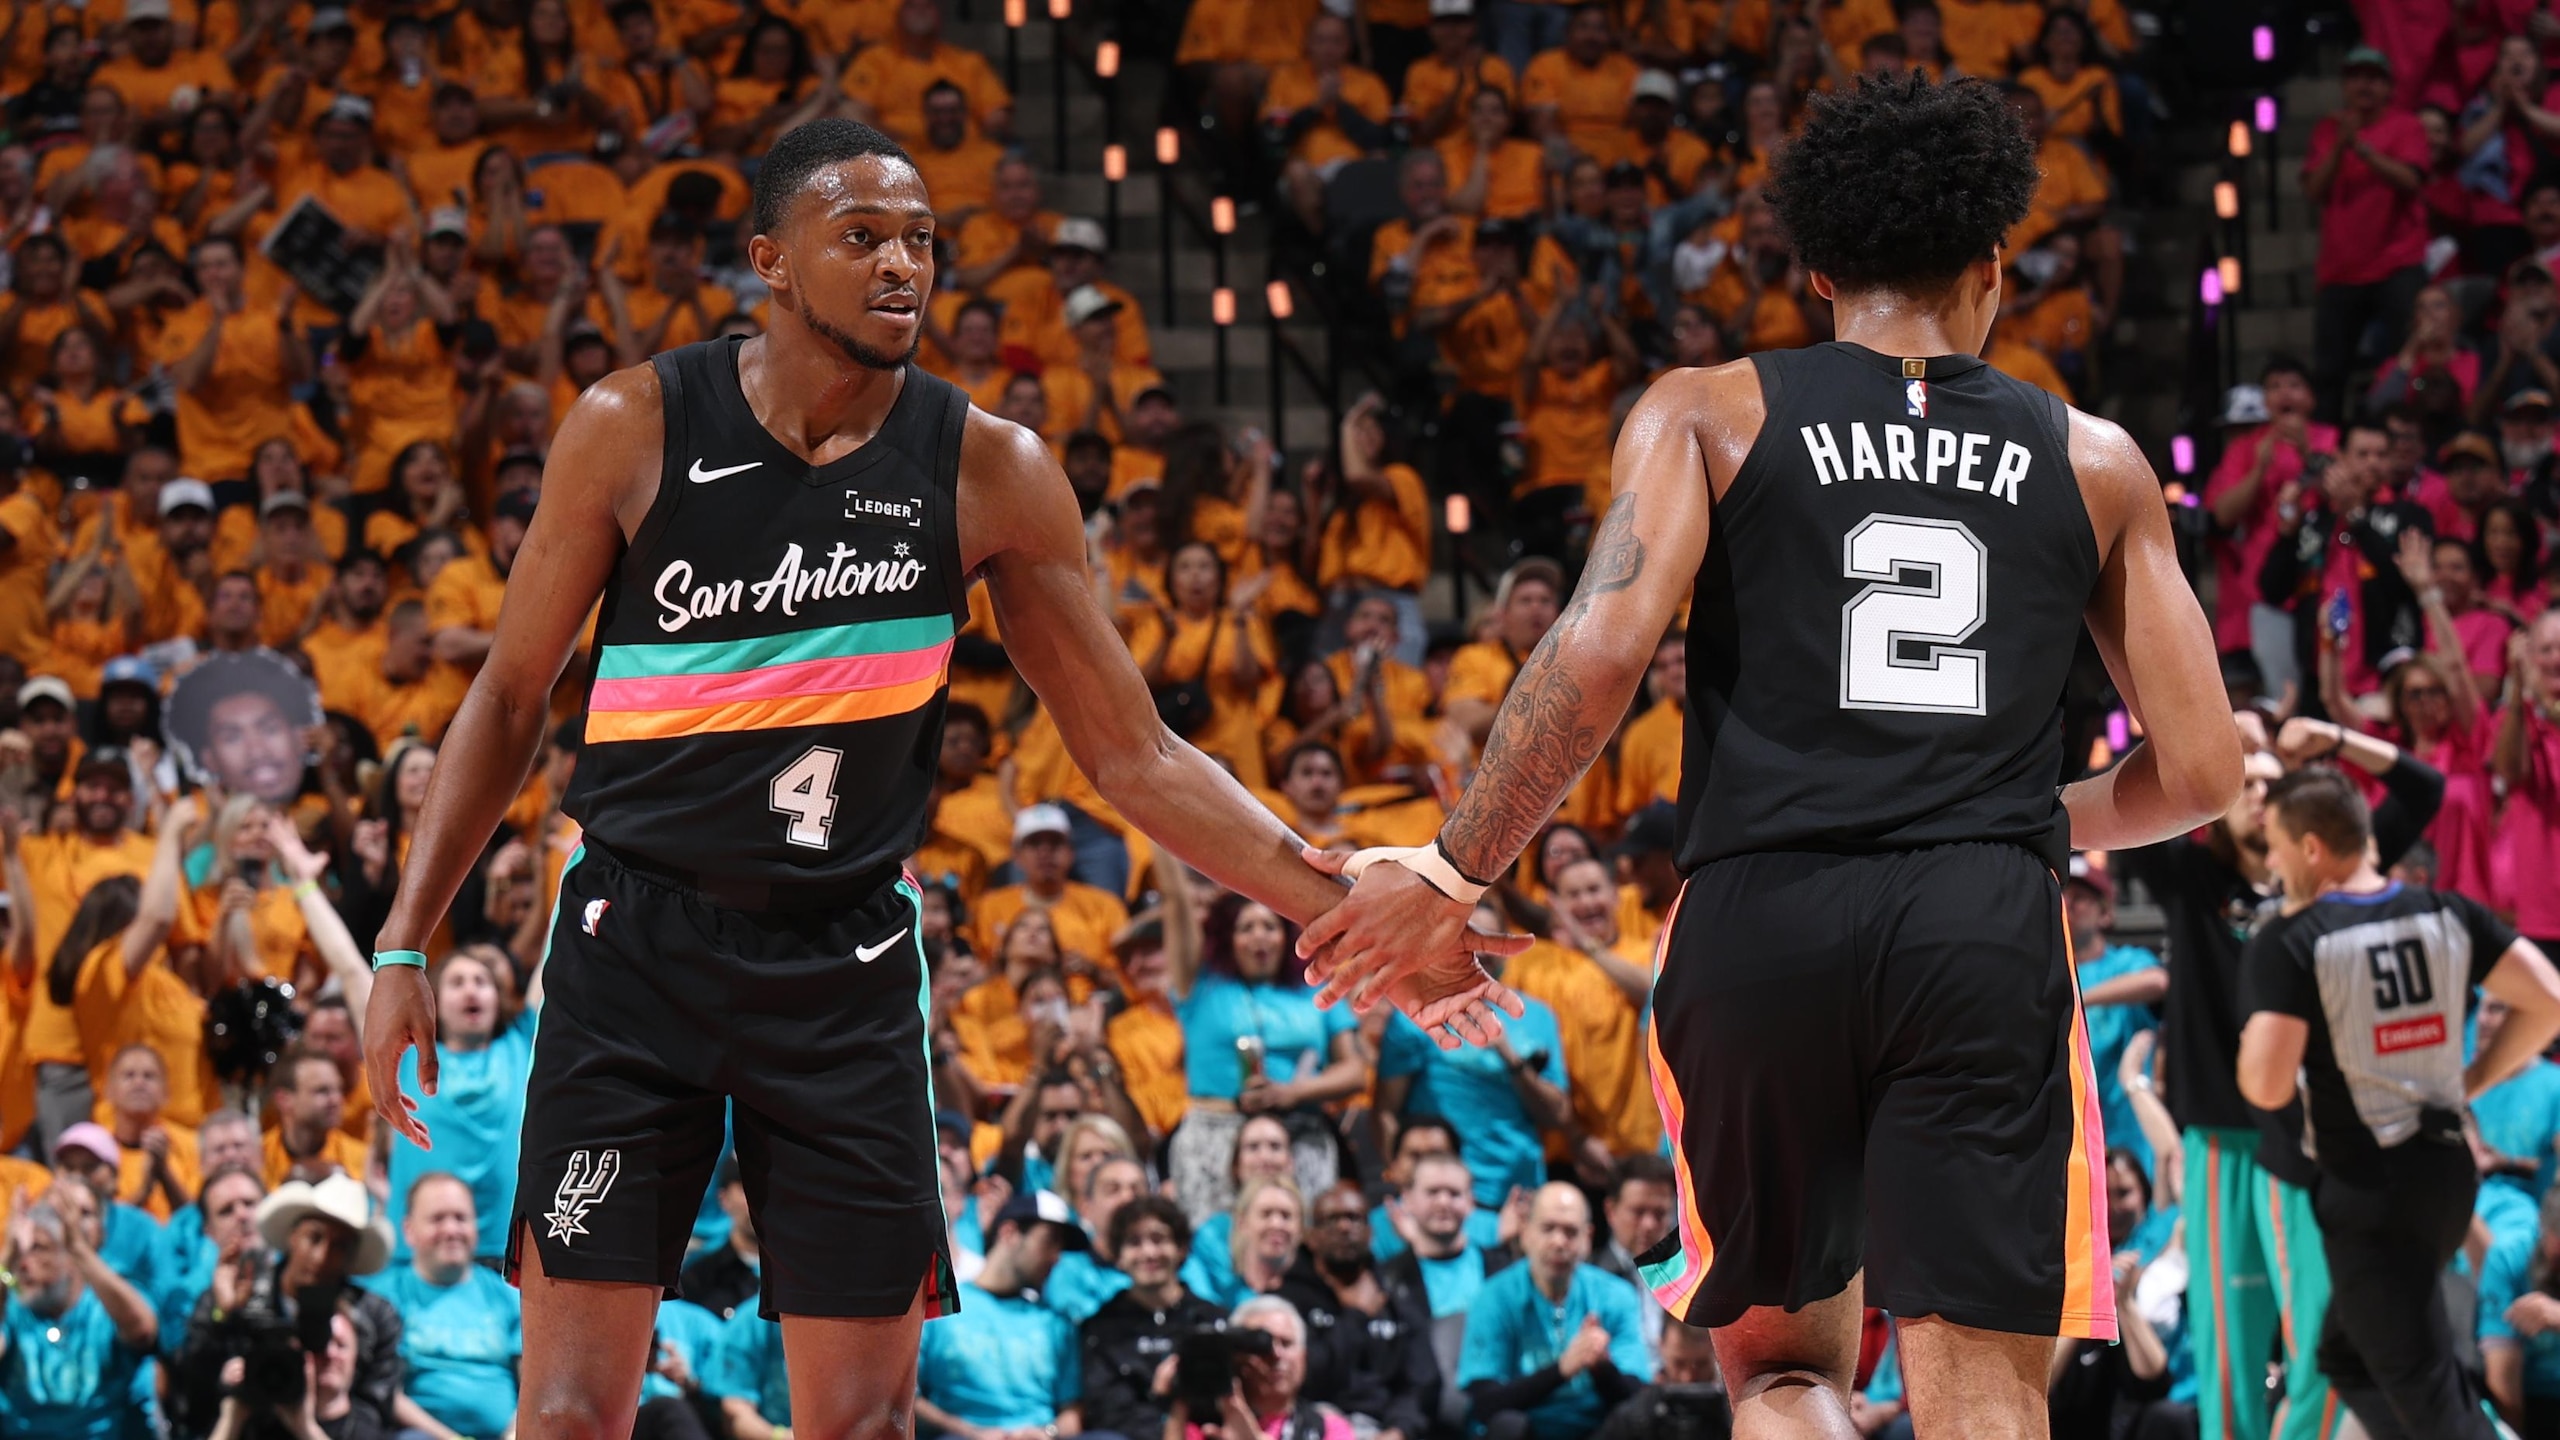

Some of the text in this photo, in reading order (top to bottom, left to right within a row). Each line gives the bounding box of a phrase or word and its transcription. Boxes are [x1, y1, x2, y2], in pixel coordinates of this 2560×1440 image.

[1800, 422, 2033, 506] HARPER
[855, 498, 912, 518] LEDGER
[654, 541, 926, 633] San Antonio
[1840, 512, 1989, 717] 2
[768, 745, 844, 851] 4
[2366, 937, 2434, 1010] 50
[2379, 1023, 2441, 1049] Emirates
